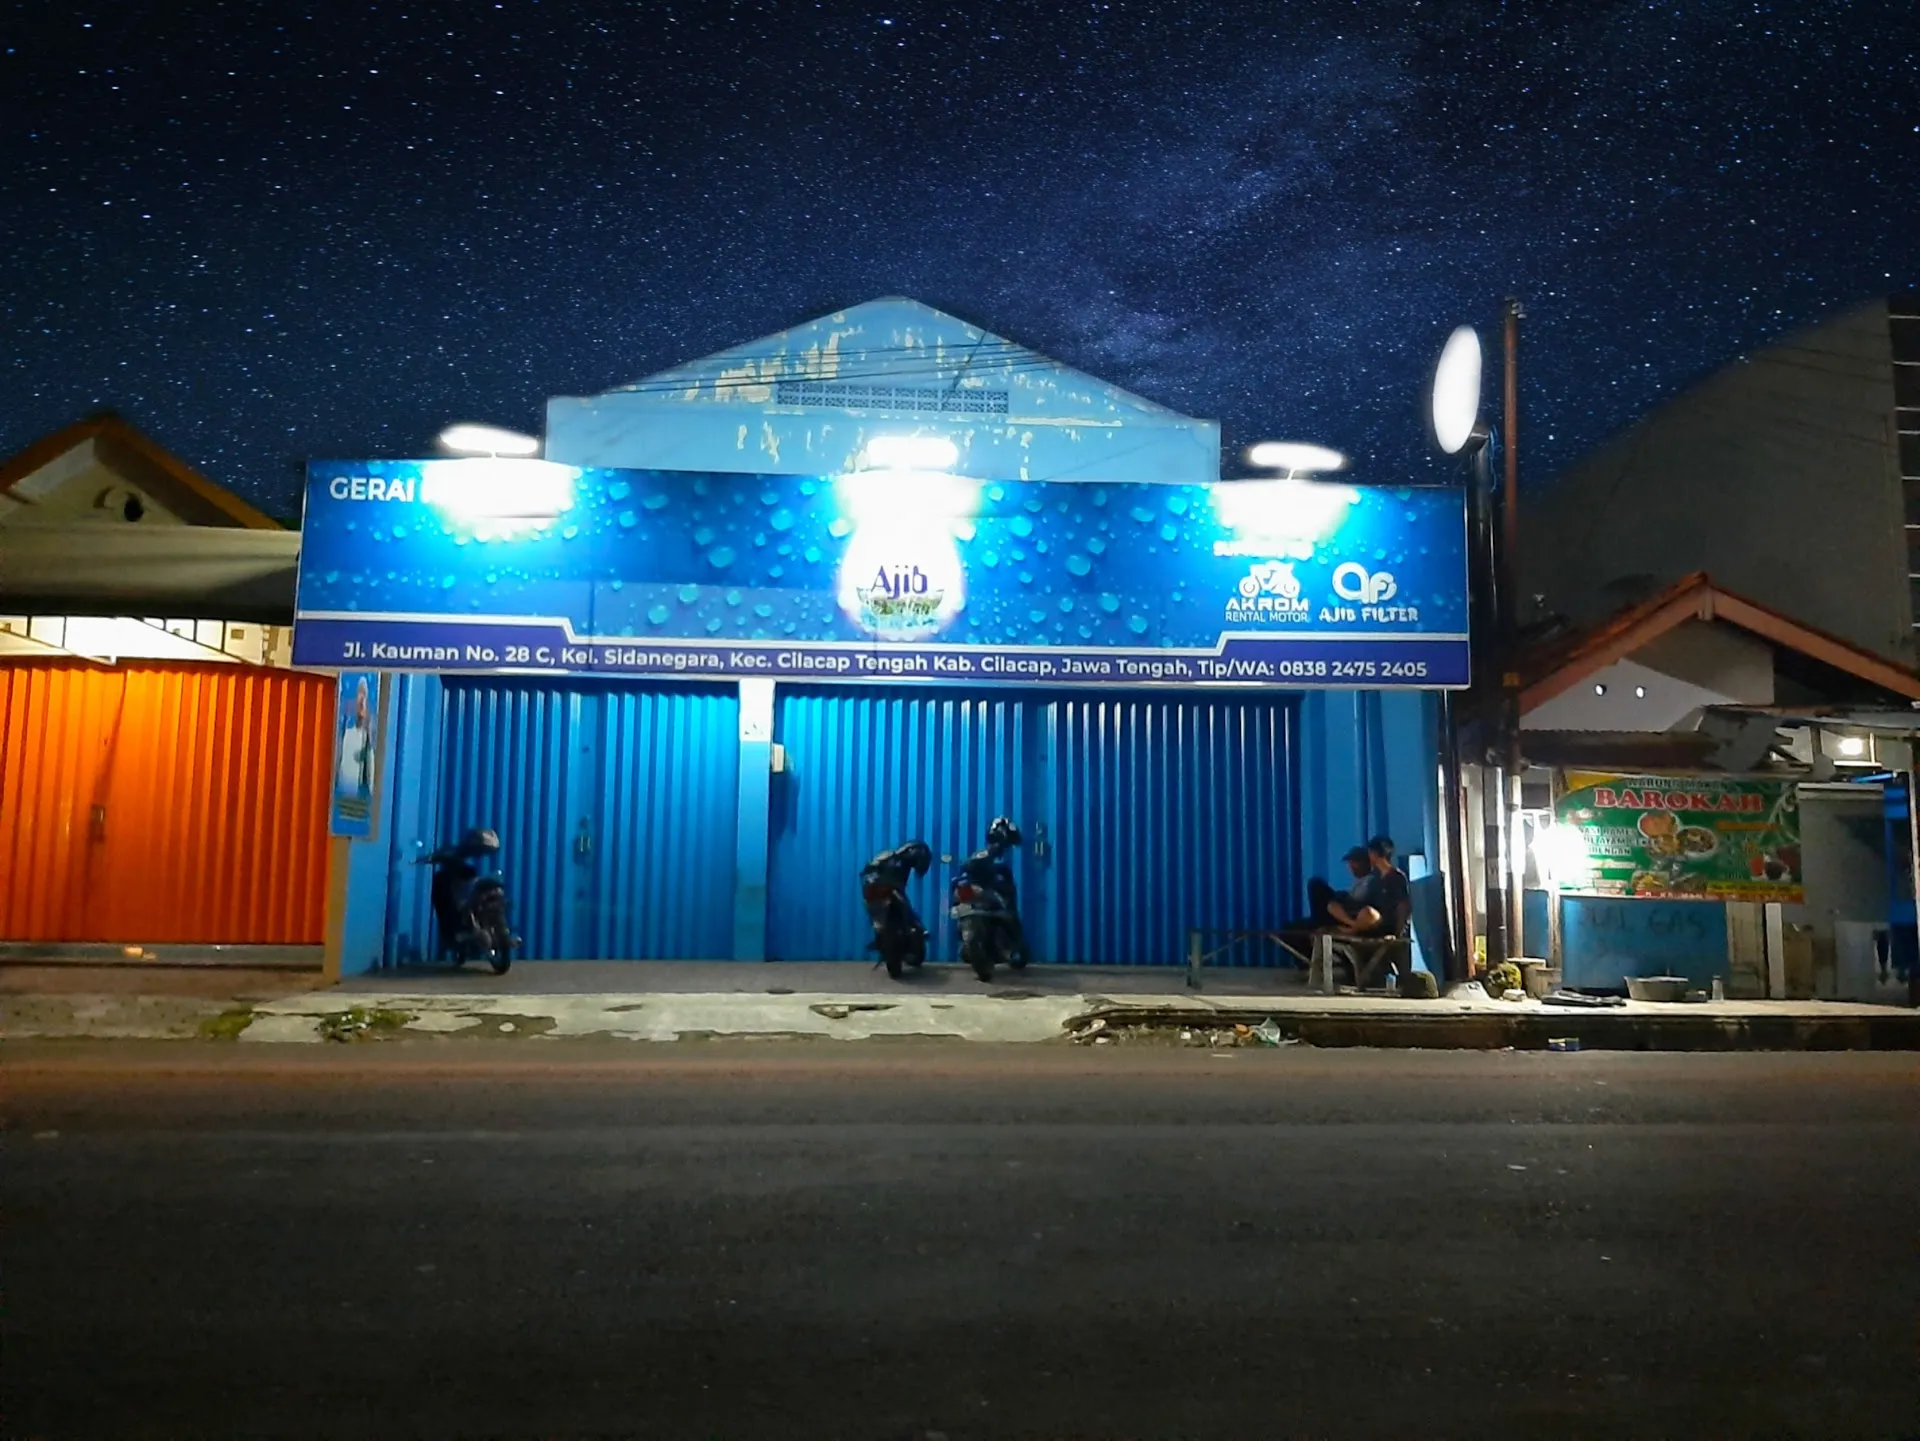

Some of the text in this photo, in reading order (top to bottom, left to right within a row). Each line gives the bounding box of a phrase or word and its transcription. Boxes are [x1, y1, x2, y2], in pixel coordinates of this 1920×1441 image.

[329, 477, 415, 502] GERAI
[870, 565, 928, 600] Ajib
[1225, 598, 1309, 611] AKROM
[1225, 611, 1309, 622] RENTAL MOTOR
[1361, 607, 1418, 622] FILTER
[343, 642, 1427, 678] Jl. Kauman No. 28 C, Kel. Sidanegara, Kec. Cilacap Tengah Kab. Cilacap, Jawa Tengah, Tlp/WA: 0838 2475 2405
[1593, 787, 1764, 813] BAROKAH
